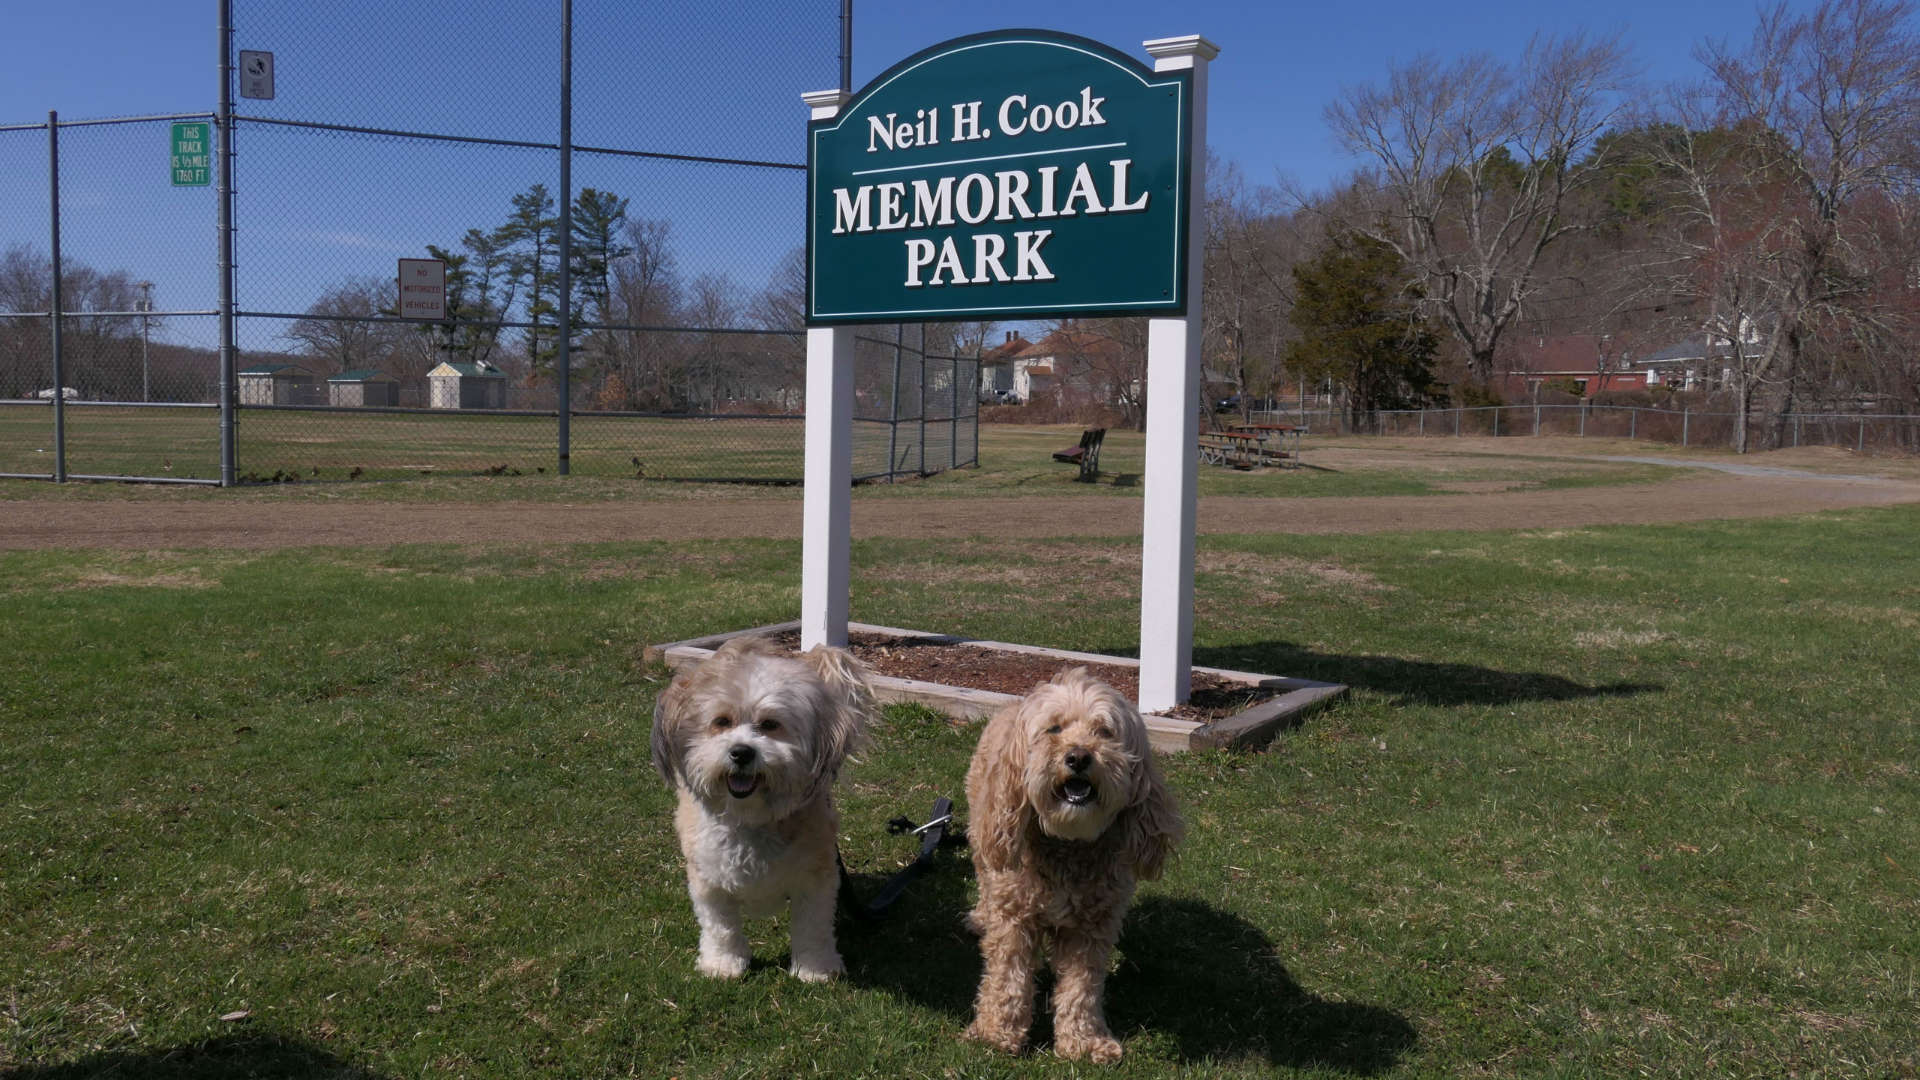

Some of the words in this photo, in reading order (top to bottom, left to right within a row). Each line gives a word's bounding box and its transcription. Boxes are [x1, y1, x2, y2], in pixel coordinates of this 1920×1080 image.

[867, 107, 938, 152] Neil
[951, 101, 990, 142] H.
[998, 86, 1106, 136] Cook
[183, 127, 200, 139] THIS
[178, 141, 202, 153] TRACK
[192, 155, 208, 168] MILE
[176, 169, 193, 182] 1760
[195, 169, 204, 182] FT
[831, 159, 1149, 234] MEMORIAL
[904, 229, 1055, 287] PARK
[416, 269, 428, 277] NO
[405, 301, 441, 310] VEHICLES
